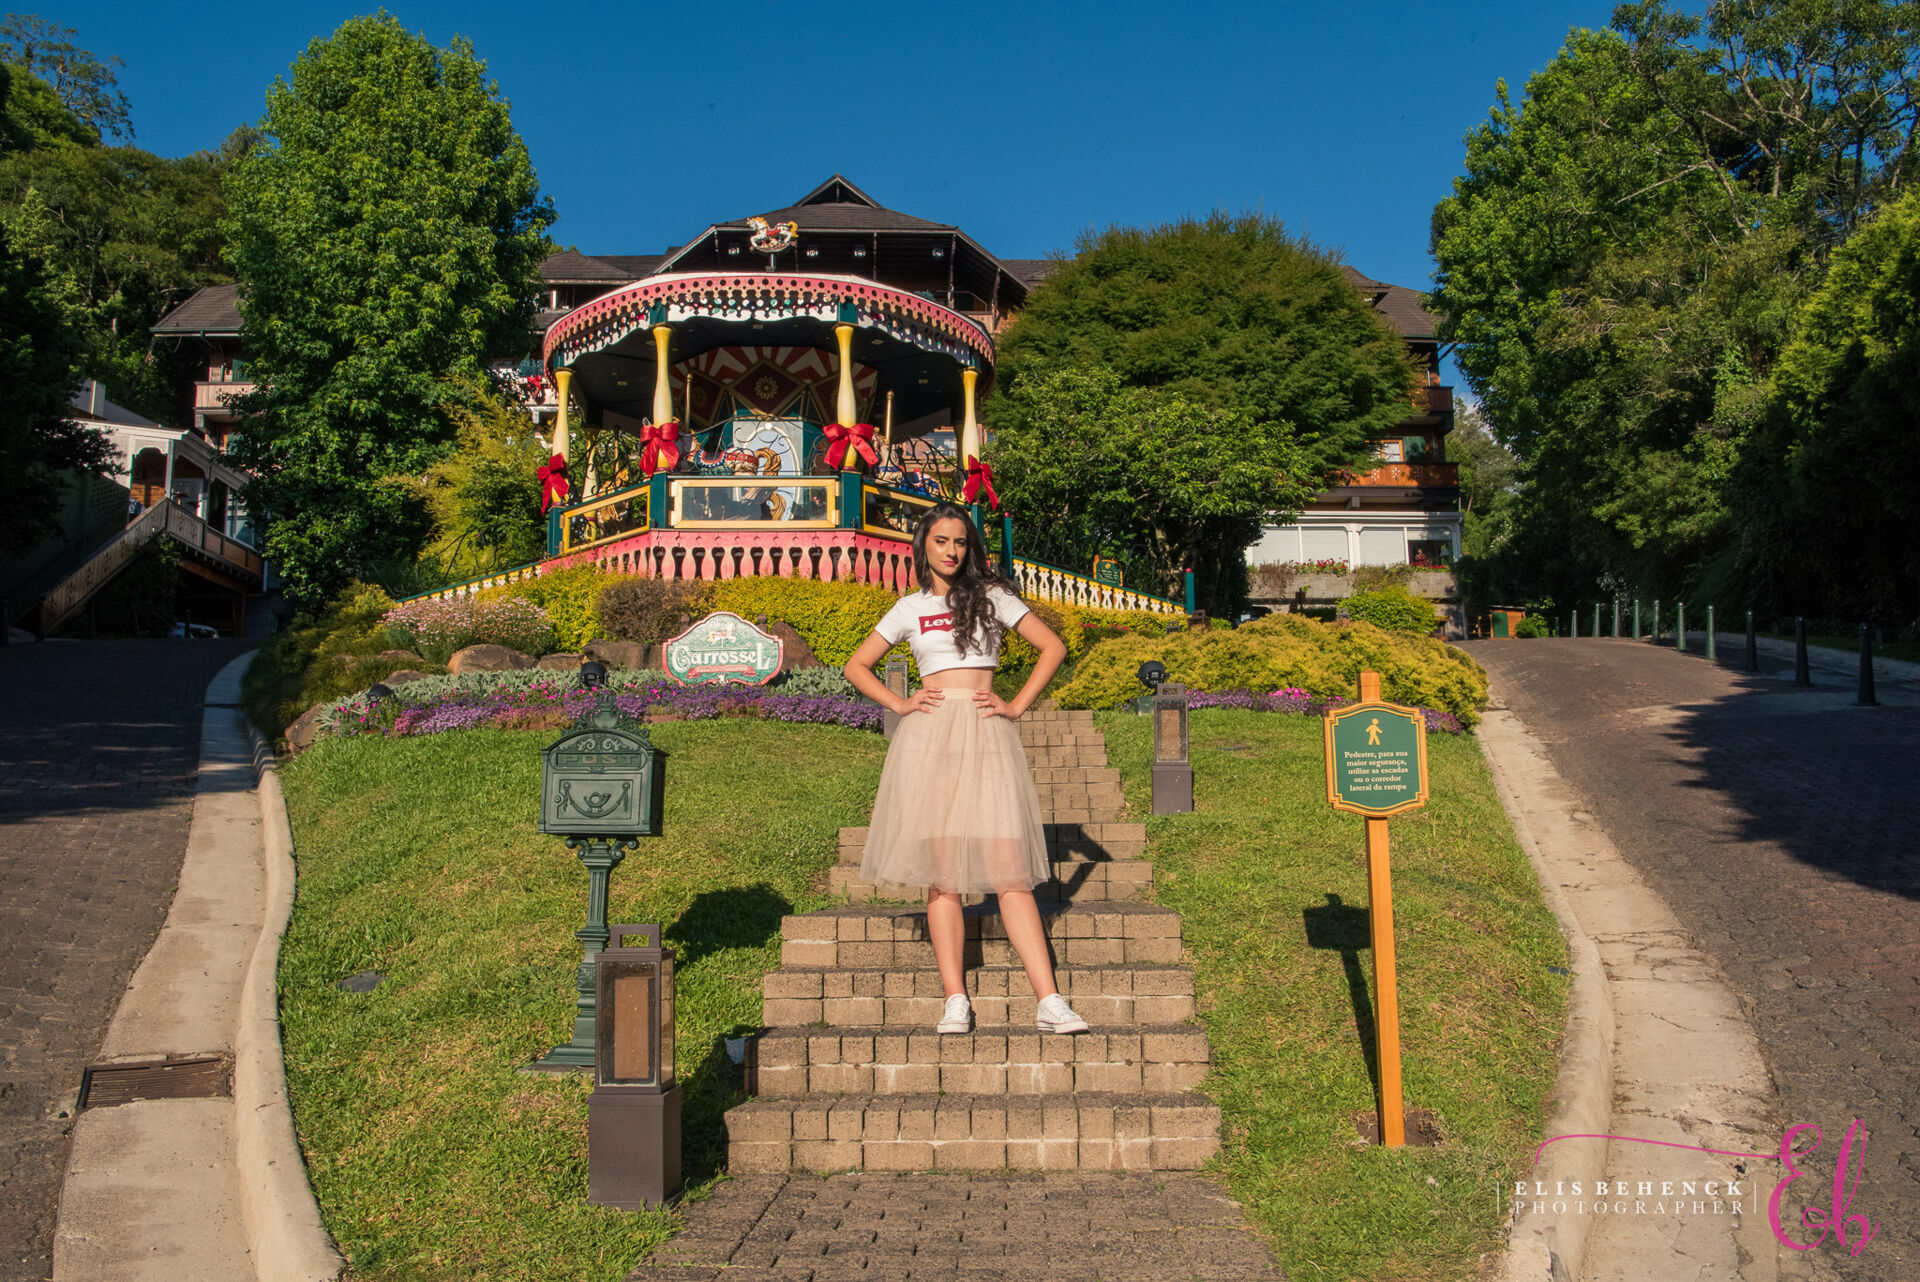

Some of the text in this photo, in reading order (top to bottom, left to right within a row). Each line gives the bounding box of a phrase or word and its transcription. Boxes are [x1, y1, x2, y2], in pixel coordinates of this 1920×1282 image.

[561, 753, 636, 764] POST
[1344, 751, 1377, 759] Pedestre,
[1378, 751, 1394, 759] para
[1369, 759, 1407, 767] segurança,
[1348, 767, 1370, 775] utilize
[1384, 784, 1407, 792] rampa
